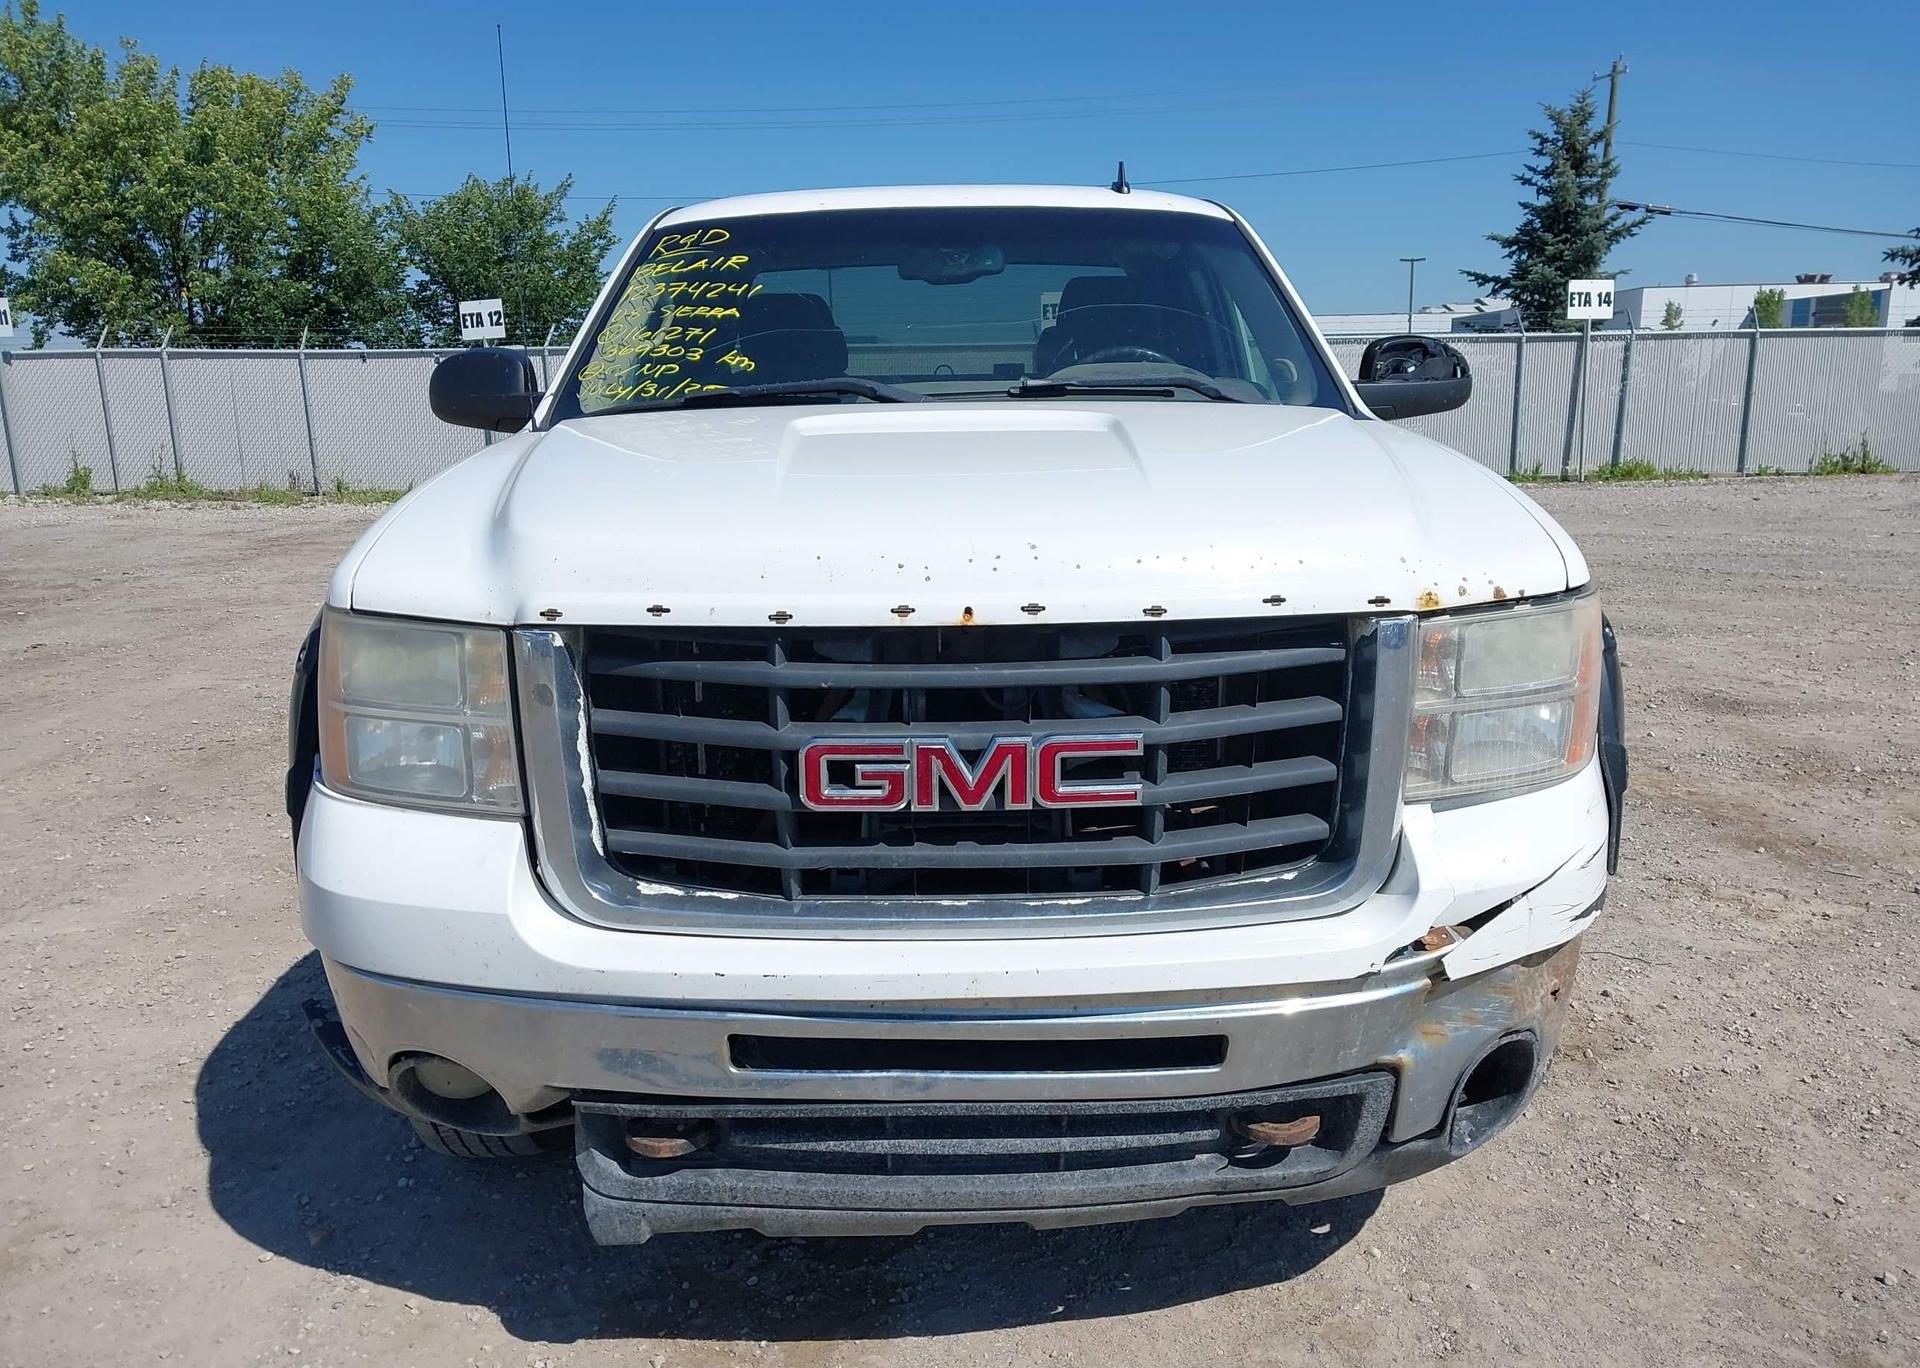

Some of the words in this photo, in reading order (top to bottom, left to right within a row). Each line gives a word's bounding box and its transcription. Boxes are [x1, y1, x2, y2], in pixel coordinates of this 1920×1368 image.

[629, 255, 749, 284] BELAIR
[1569, 291, 1592, 307] ETA
[1597, 291, 1612, 307] 14
[461, 311, 485, 329] ETA
[487, 310, 503, 327] 12
[799, 729, 1144, 812] GMC
